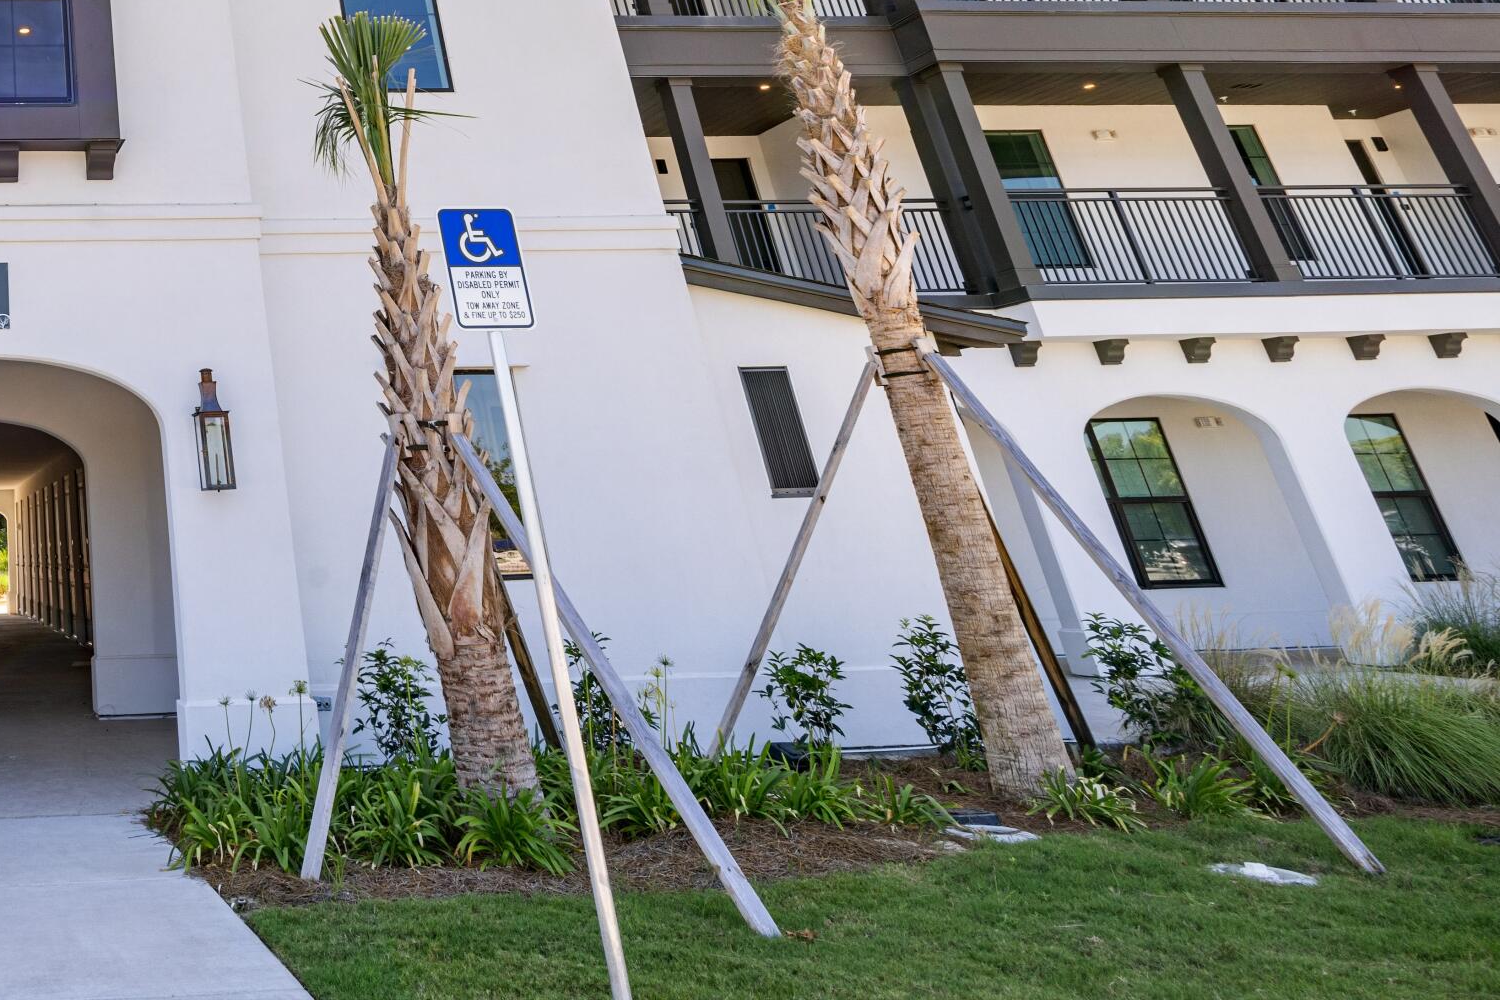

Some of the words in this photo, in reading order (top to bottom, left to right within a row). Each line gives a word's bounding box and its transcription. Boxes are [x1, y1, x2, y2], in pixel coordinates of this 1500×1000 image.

[465, 270, 497, 278] PARKING
[498, 270, 508, 278] BY
[457, 281, 492, 289] DISABLED
[494, 281, 520, 289] PERMIT
[481, 290, 500, 298] ONLY
[466, 302, 480, 310] TOW
[482, 302, 499, 310] AWAY
[502, 302, 520, 310] ZONE
[464, 311, 470, 319] &
[471, 311, 486, 319] FINE
[487, 311, 497, 319] UP
[499, 311, 507, 319] TO
[509, 310, 526, 319] $250
